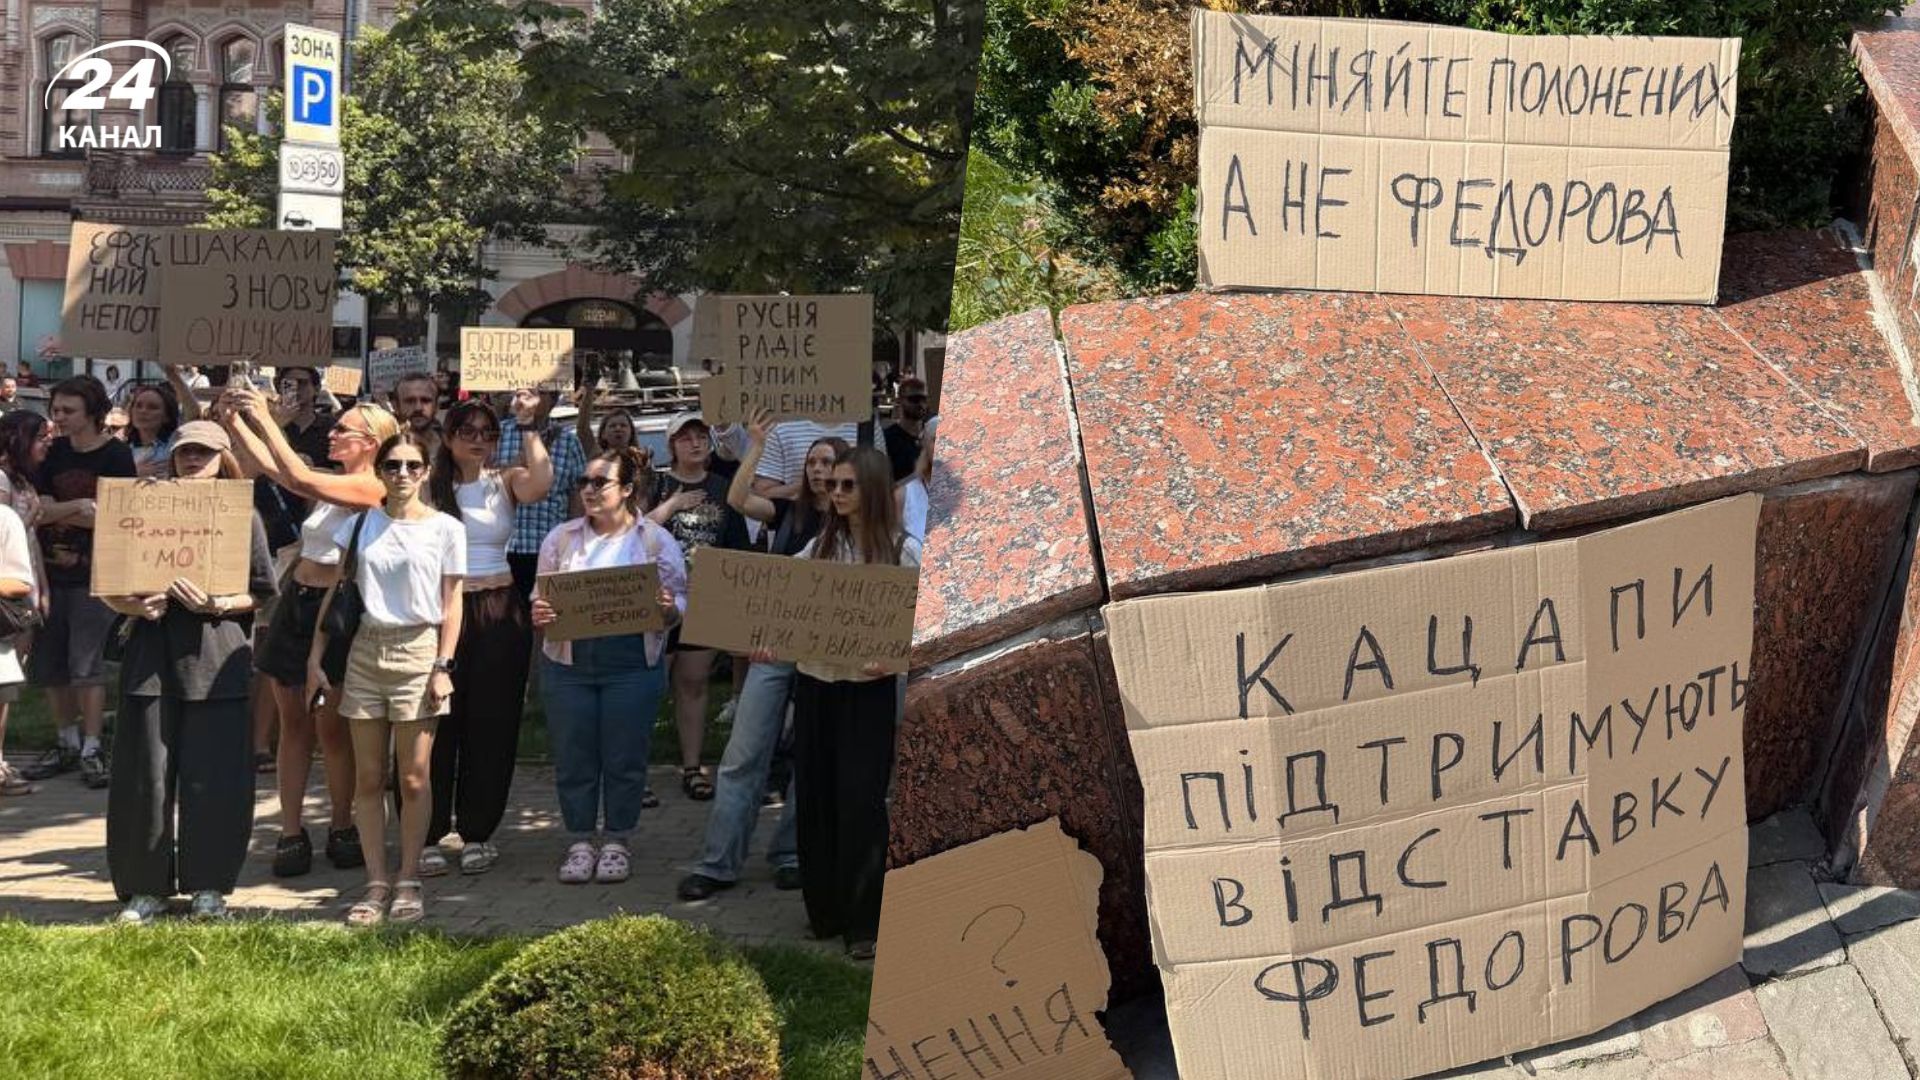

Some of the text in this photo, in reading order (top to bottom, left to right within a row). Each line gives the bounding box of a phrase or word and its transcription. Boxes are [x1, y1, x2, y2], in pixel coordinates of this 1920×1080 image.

[291, 35, 334, 61] ЗОНА
[1232, 36, 1738, 121] МІНЯЙТЕ ПОЛОНЕНИХ
[320, 161, 336, 179] 50
[1222, 153, 1684, 266] А НЕ ФЕДОРОВА
[169, 232, 320, 266] ШАКАЛИ
[736, 301, 817, 329] РУСНЯ
[186, 317, 331, 361] ОШУКАЛИ
[465, 331, 561, 351] ПОТРІБНІ
[738, 334, 817, 360] РАДІЄ
[735, 365, 818, 386] ТУПИМ
[740, 388, 845, 415] РІШЕННЯМ
[720, 558, 793, 593] ЧОМУ
[807, 571, 824, 599] У
[1235, 563, 1714, 719] КАЦАПИ
[1180, 660, 1748, 831] ПІДТРИМУЮТЬ
[1212, 756, 1732, 928] ВІДСТАВКУ
[1253, 860, 1731, 1041] ФЕДОРОВА
